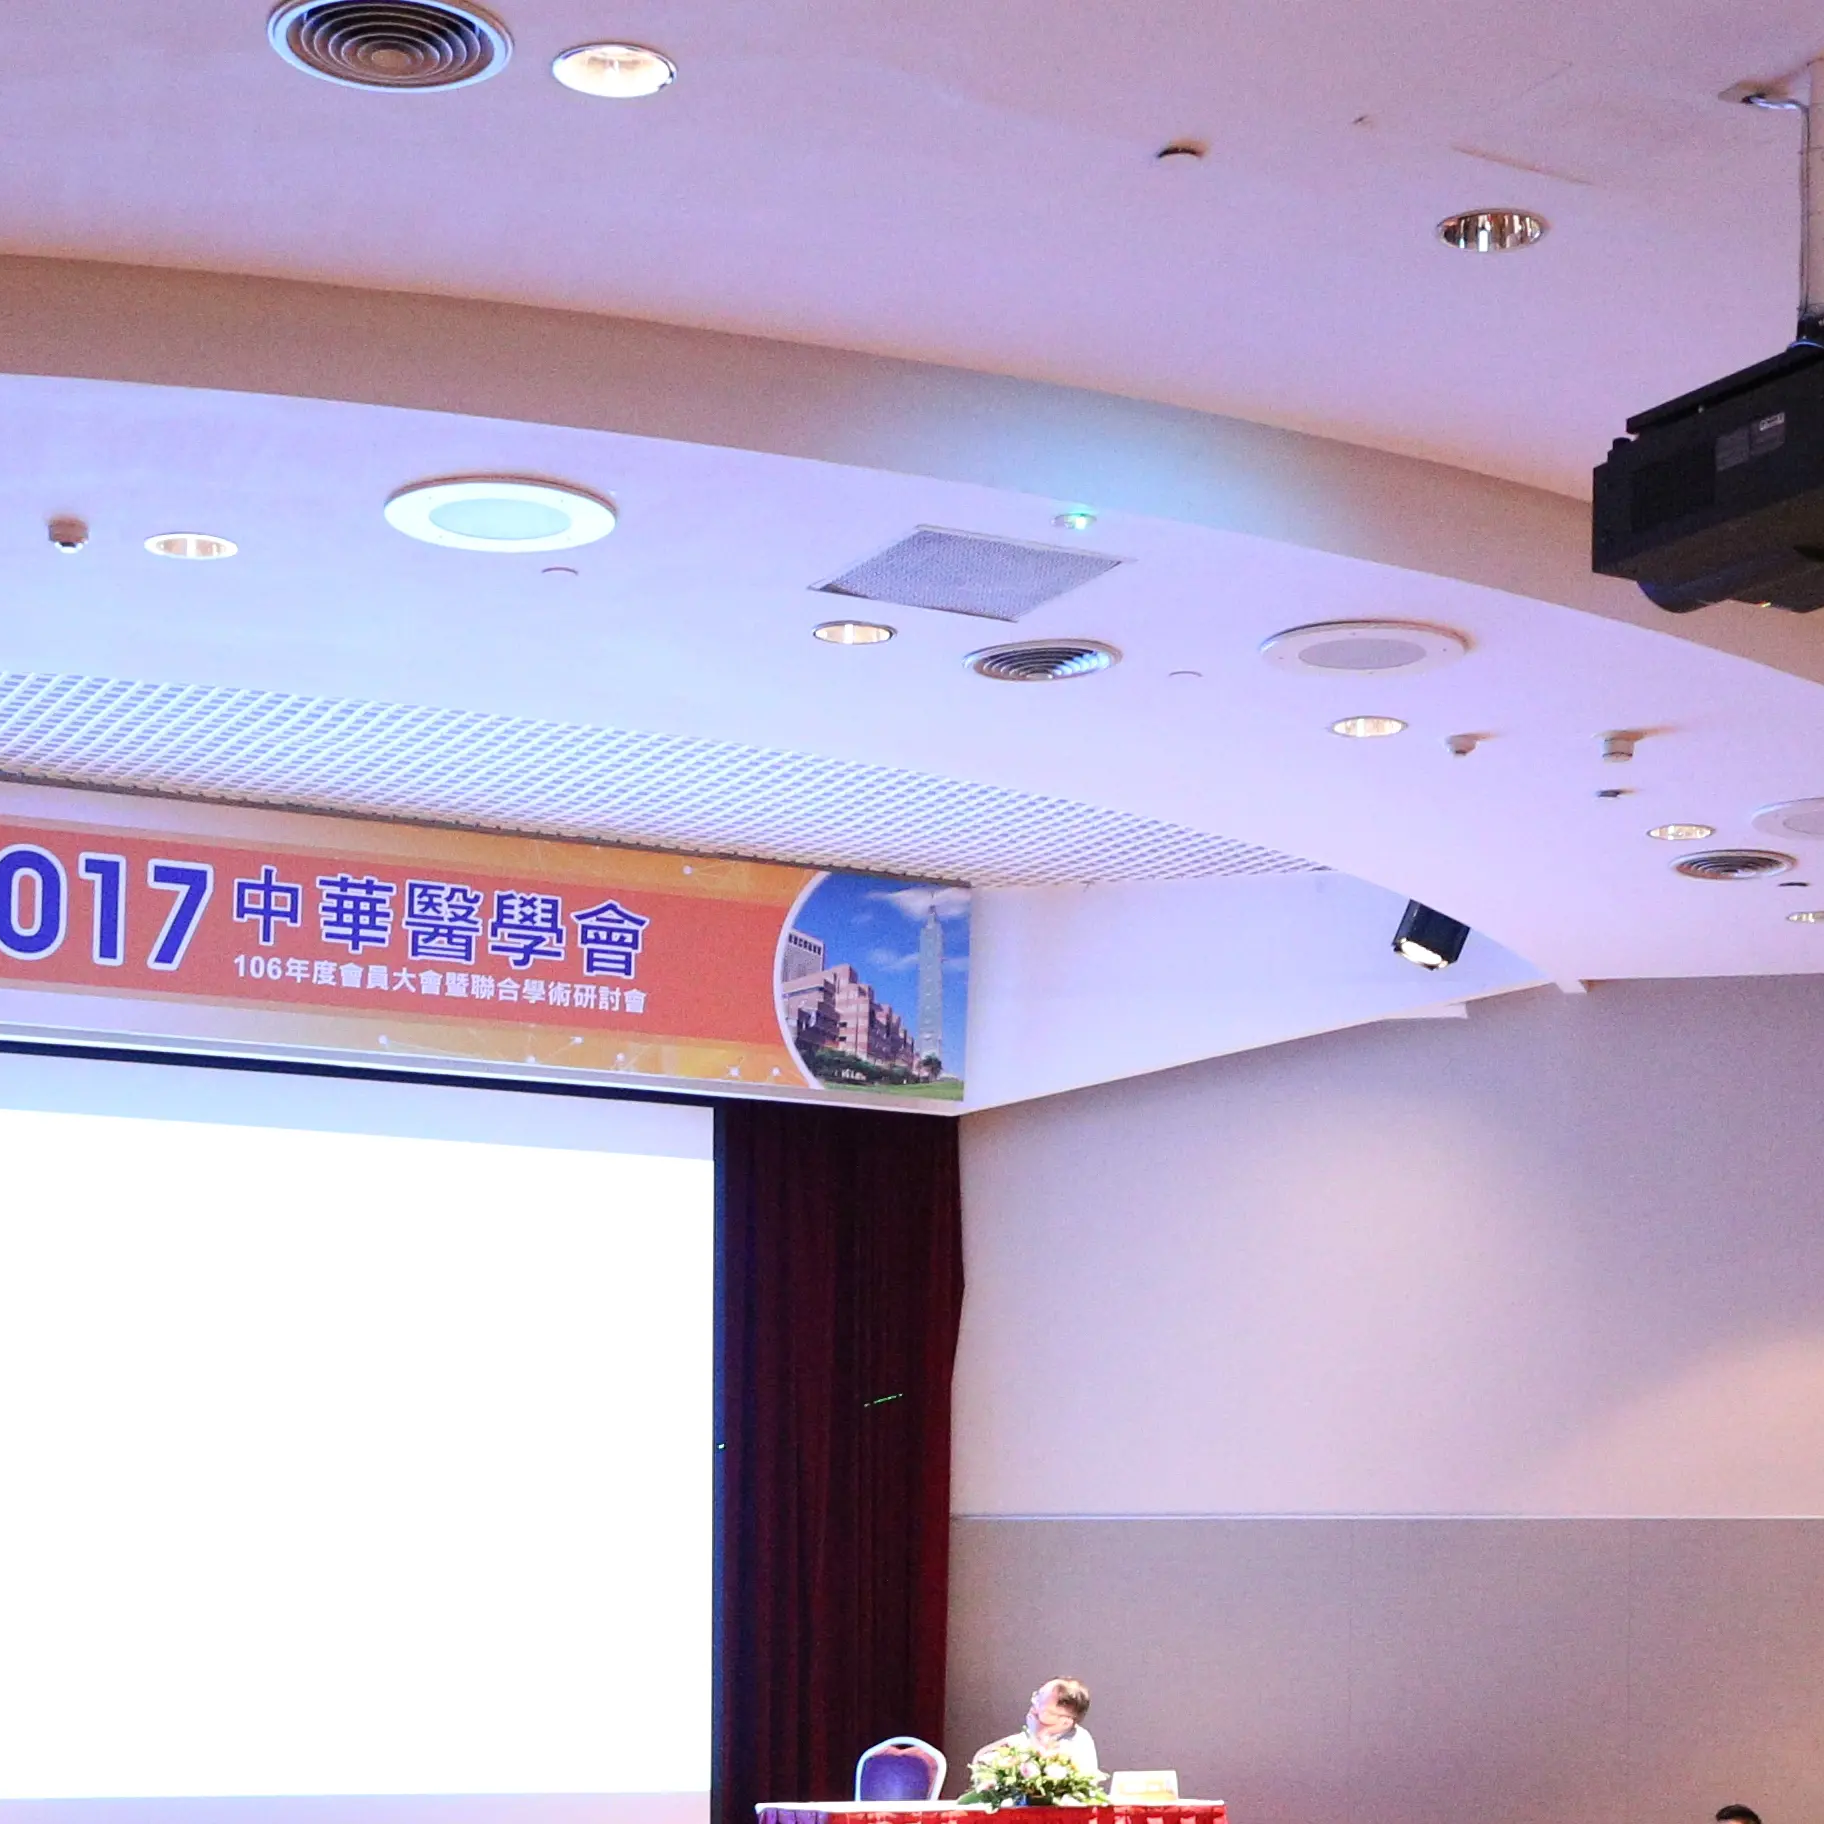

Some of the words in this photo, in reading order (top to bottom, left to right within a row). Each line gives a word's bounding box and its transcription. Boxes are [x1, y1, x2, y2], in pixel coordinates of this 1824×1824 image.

[233, 864, 650, 979] 中華醫學會
[234, 954, 647, 1014] 106年度會員大會暨聯合學術研討會
